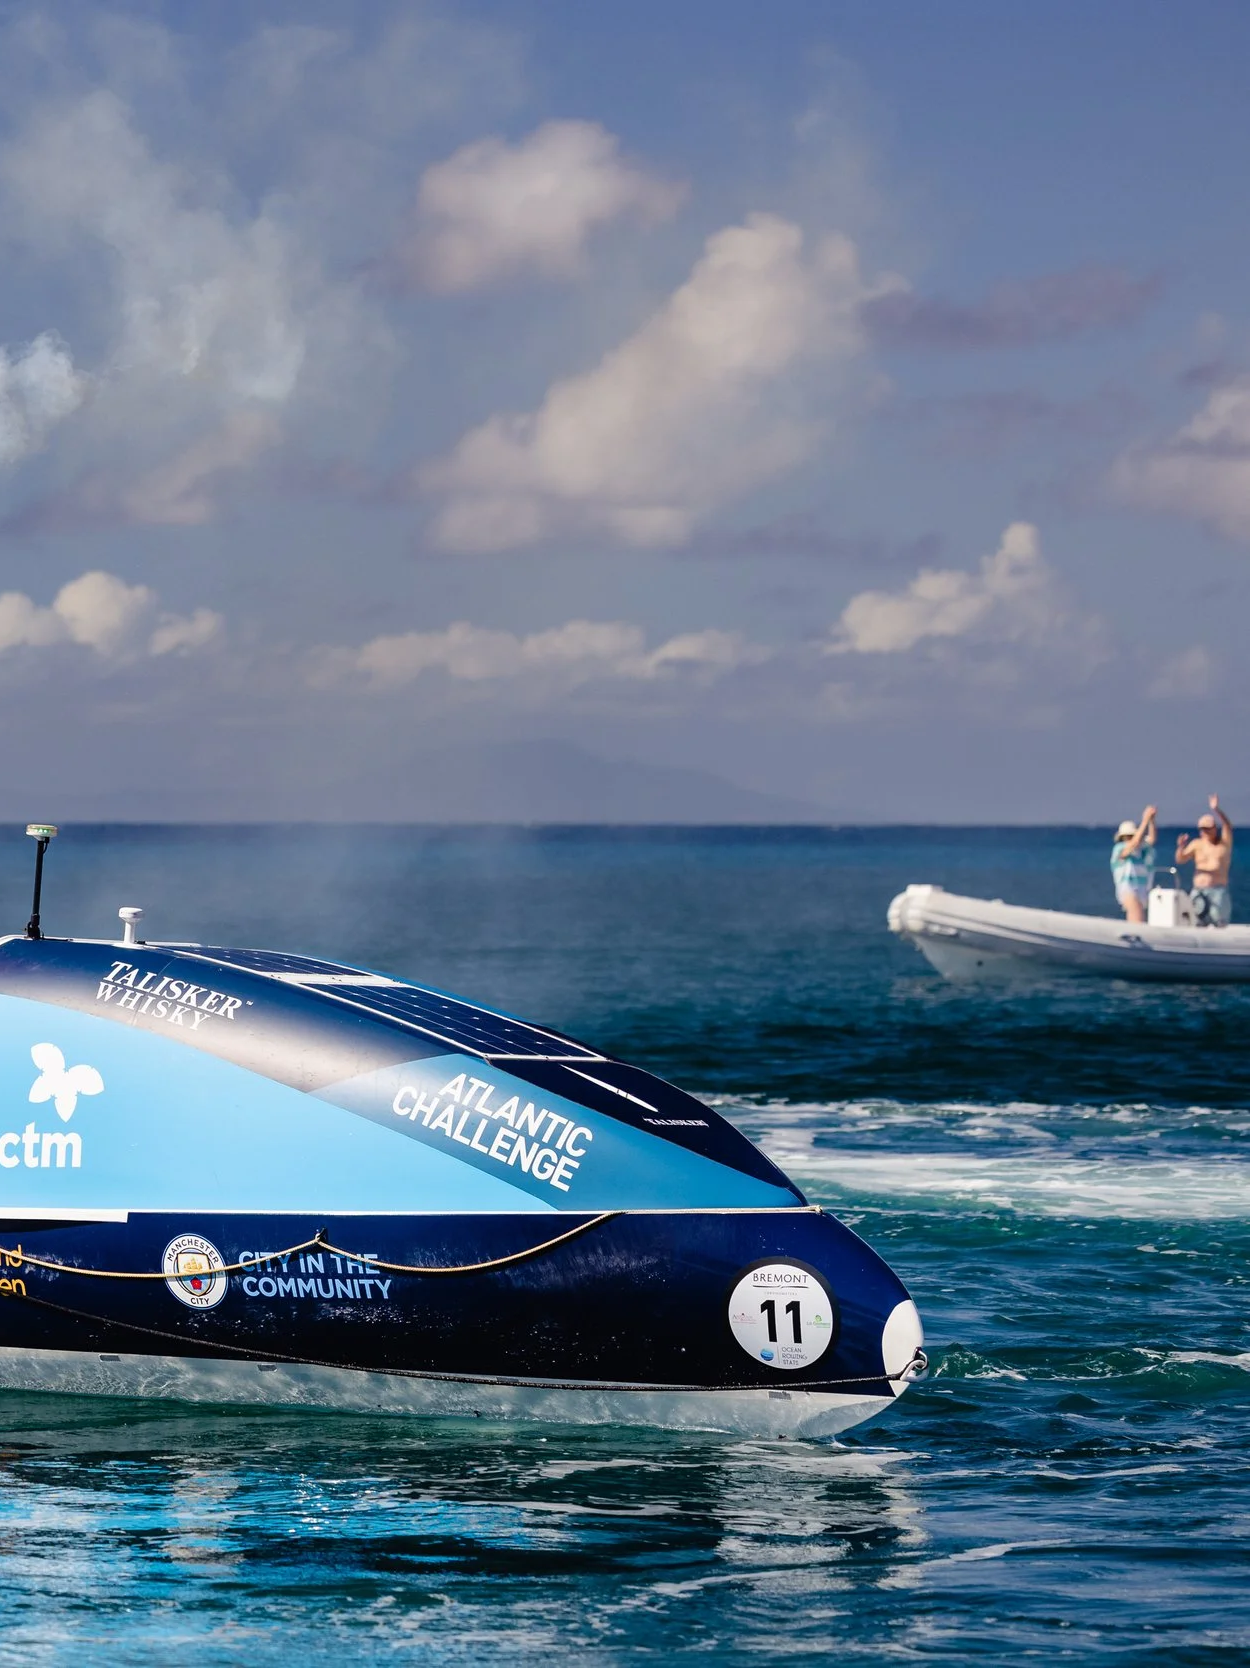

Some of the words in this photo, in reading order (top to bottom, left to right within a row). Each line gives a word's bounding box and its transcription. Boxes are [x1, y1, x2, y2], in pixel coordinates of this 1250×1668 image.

[95, 981, 211, 1031] WHISKY
[102, 960, 243, 1020] TALISKER
[438, 1073, 593, 1157] ATLANTIC
[392, 1086, 580, 1192] CHALLENGE
[167, 1238, 219, 1264] MANCHESTER
[238, 1251, 292, 1273] CITY
[299, 1252, 325, 1274] IN
[330, 1253, 381, 1275] THE
[242, 1276, 392, 1300] COMMUNITY
[752, 1273, 809, 1284] BREMONT
[190, 1297, 210, 1305] CITY
[760, 1299, 803, 1344] 11
